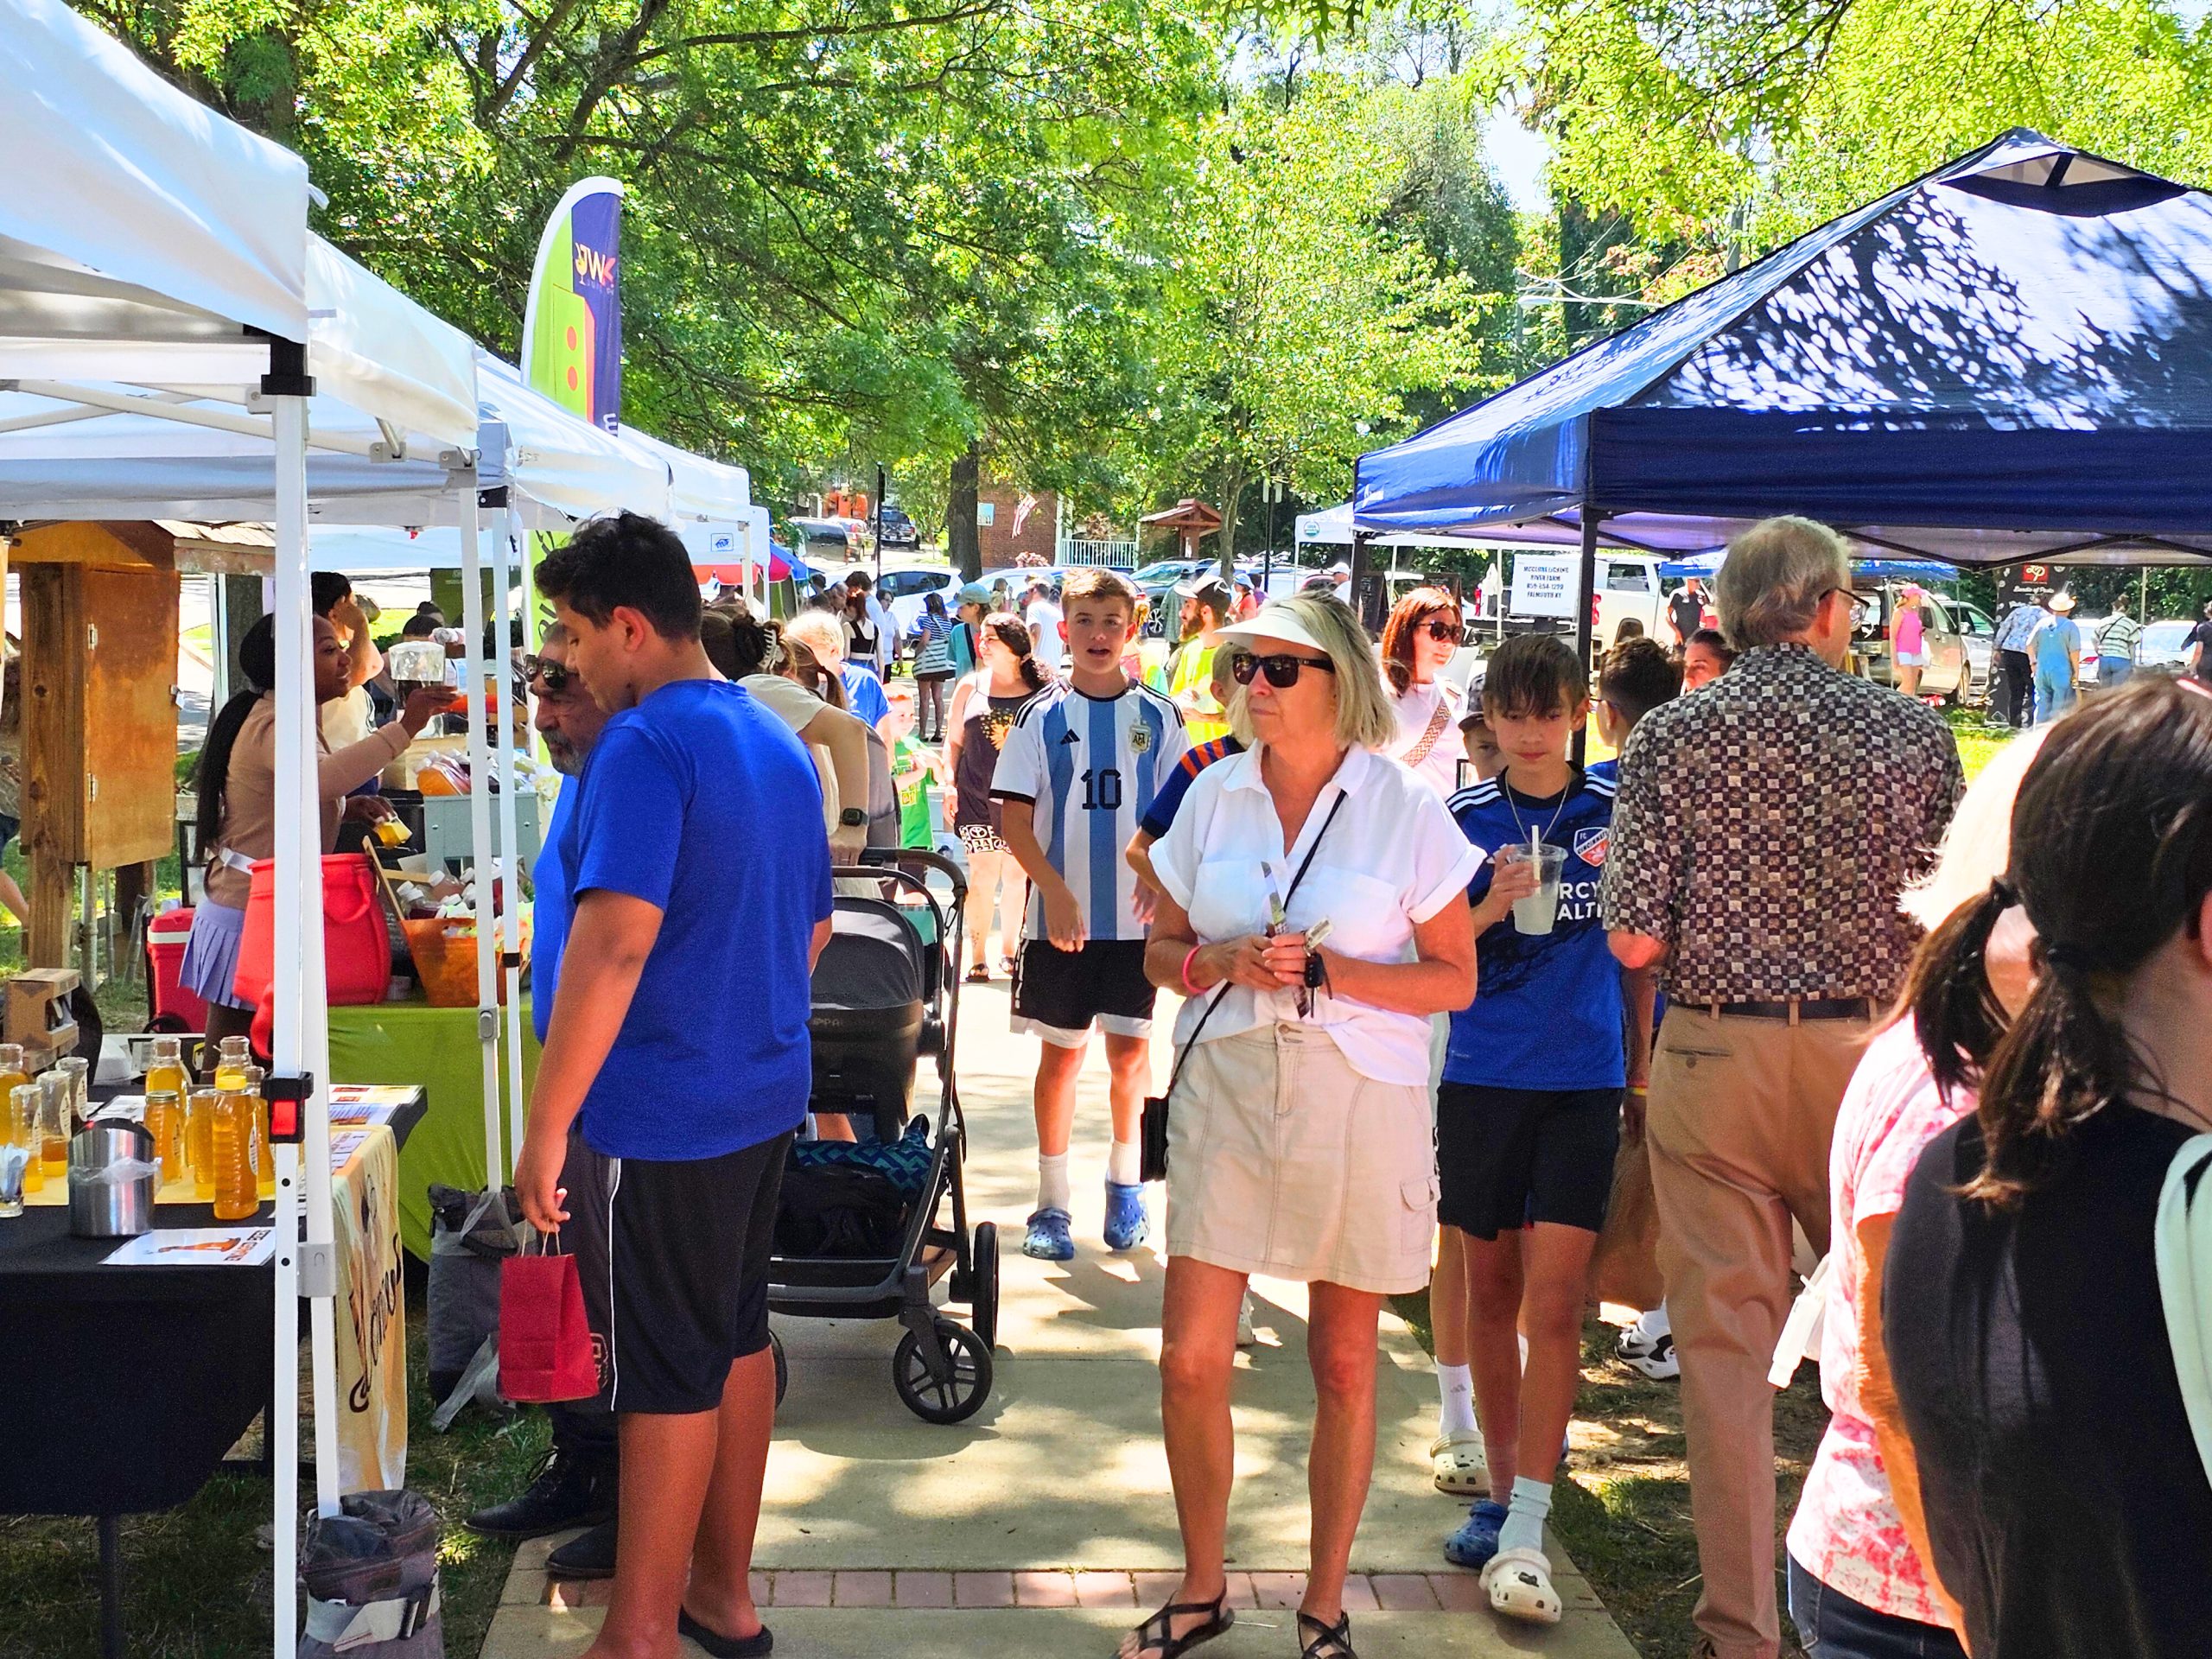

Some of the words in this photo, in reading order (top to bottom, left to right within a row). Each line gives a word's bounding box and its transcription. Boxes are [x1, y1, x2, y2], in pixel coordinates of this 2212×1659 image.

[1080, 768, 1122, 810] 10
[1559, 881, 1598, 899] RCY
[1556, 901, 1603, 921] ALT
